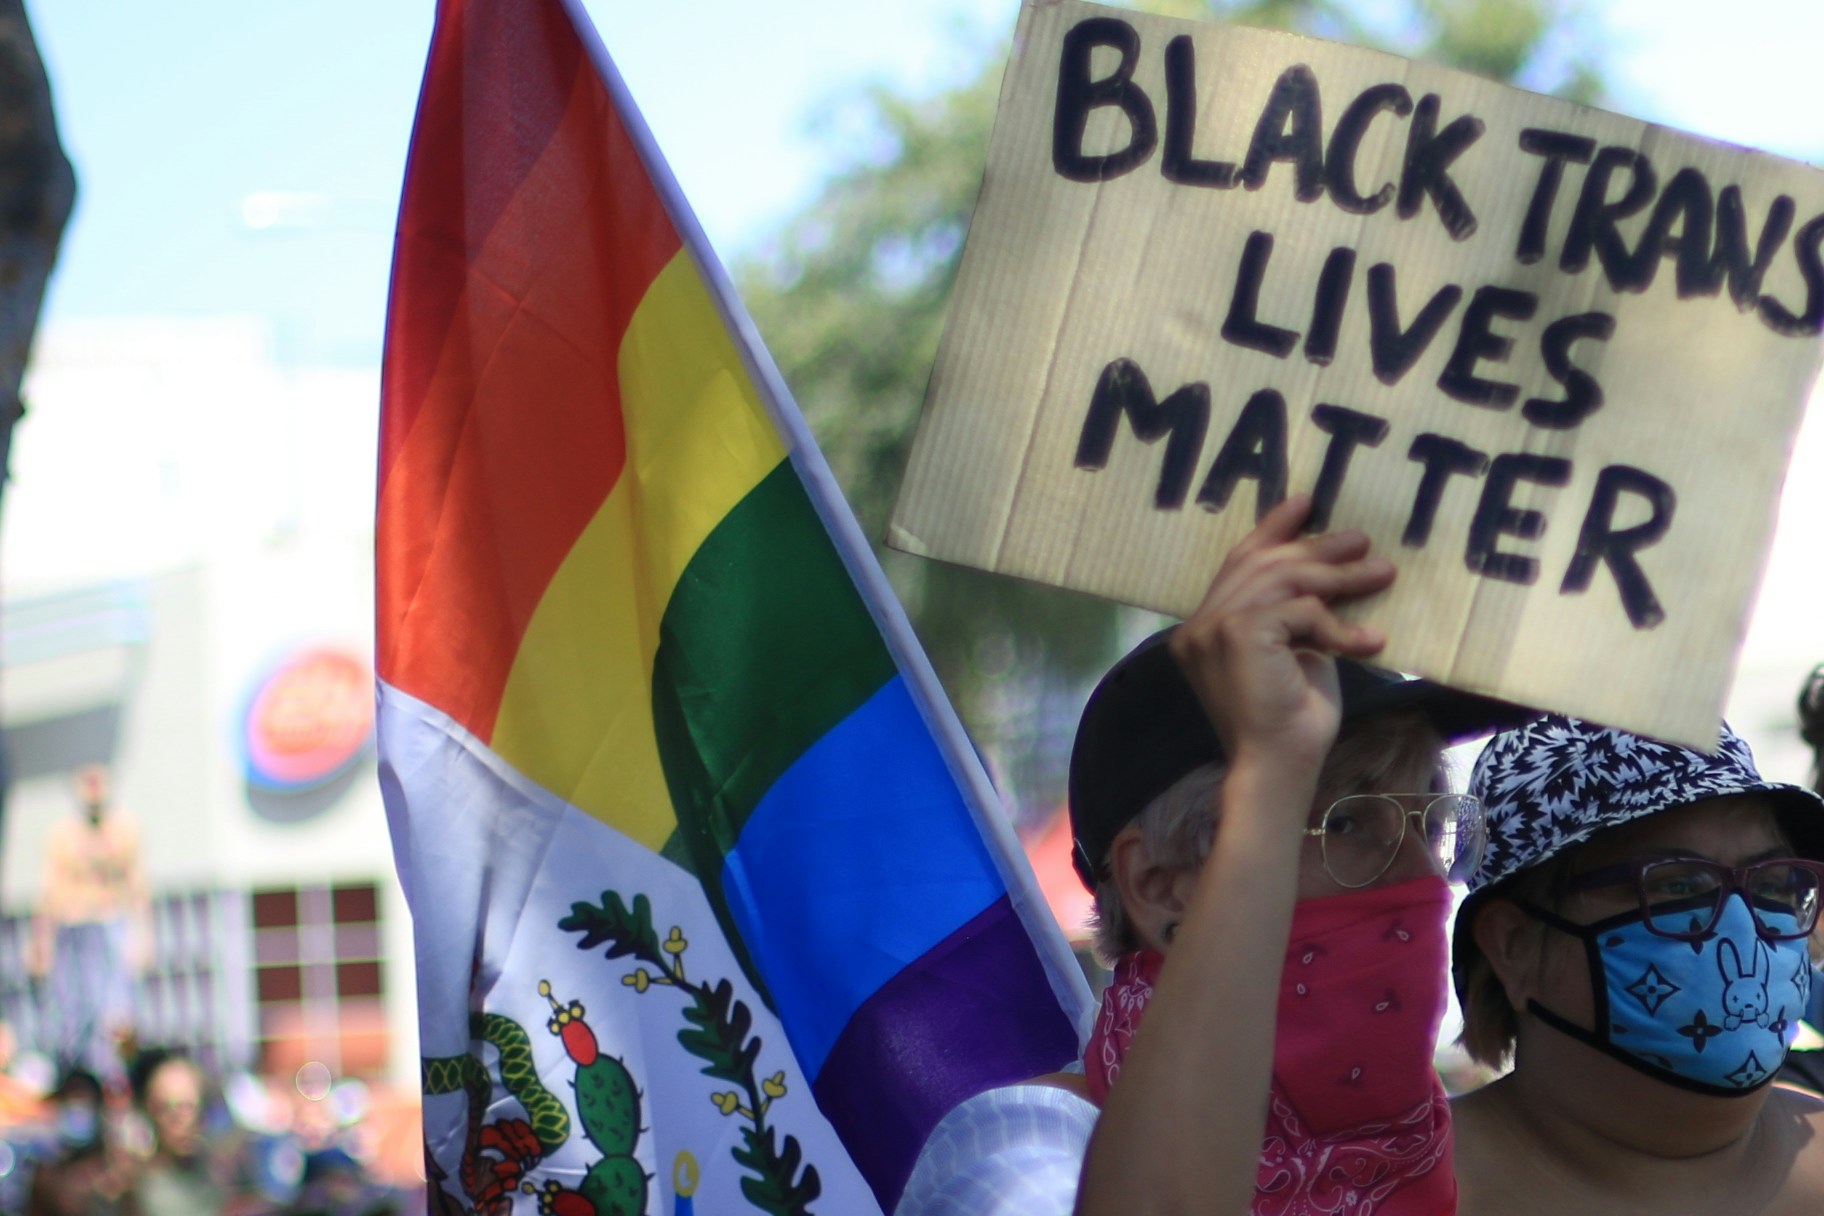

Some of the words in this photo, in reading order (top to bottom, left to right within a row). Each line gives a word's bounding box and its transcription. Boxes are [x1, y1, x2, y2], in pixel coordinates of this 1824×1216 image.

[1053, 17, 1487, 241] BLACK
[1221, 230, 1615, 430] LIVES
[1073, 357, 1676, 630] MATTER
